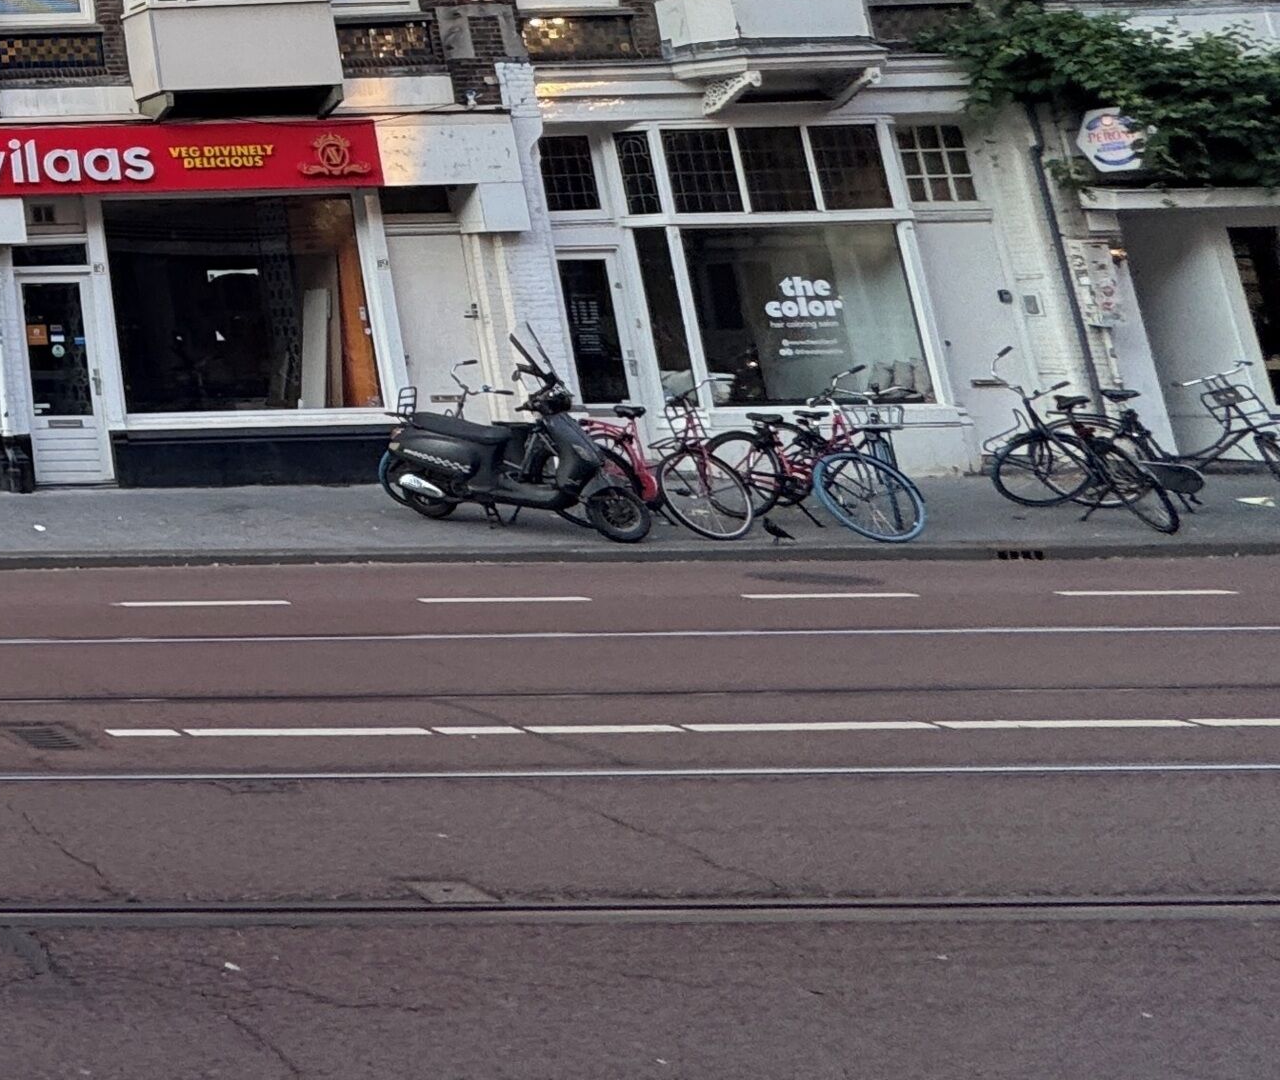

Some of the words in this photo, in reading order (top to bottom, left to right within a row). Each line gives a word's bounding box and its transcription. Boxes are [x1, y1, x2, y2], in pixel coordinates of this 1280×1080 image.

[1088, 129, 1136, 143] PERO
[168, 146, 200, 158] VEG
[203, 144, 274, 157] DIVINELY
[183, 156, 264, 169] DELICIOUS
[779, 276, 831, 297] the
[765, 297, 843, 317] color
